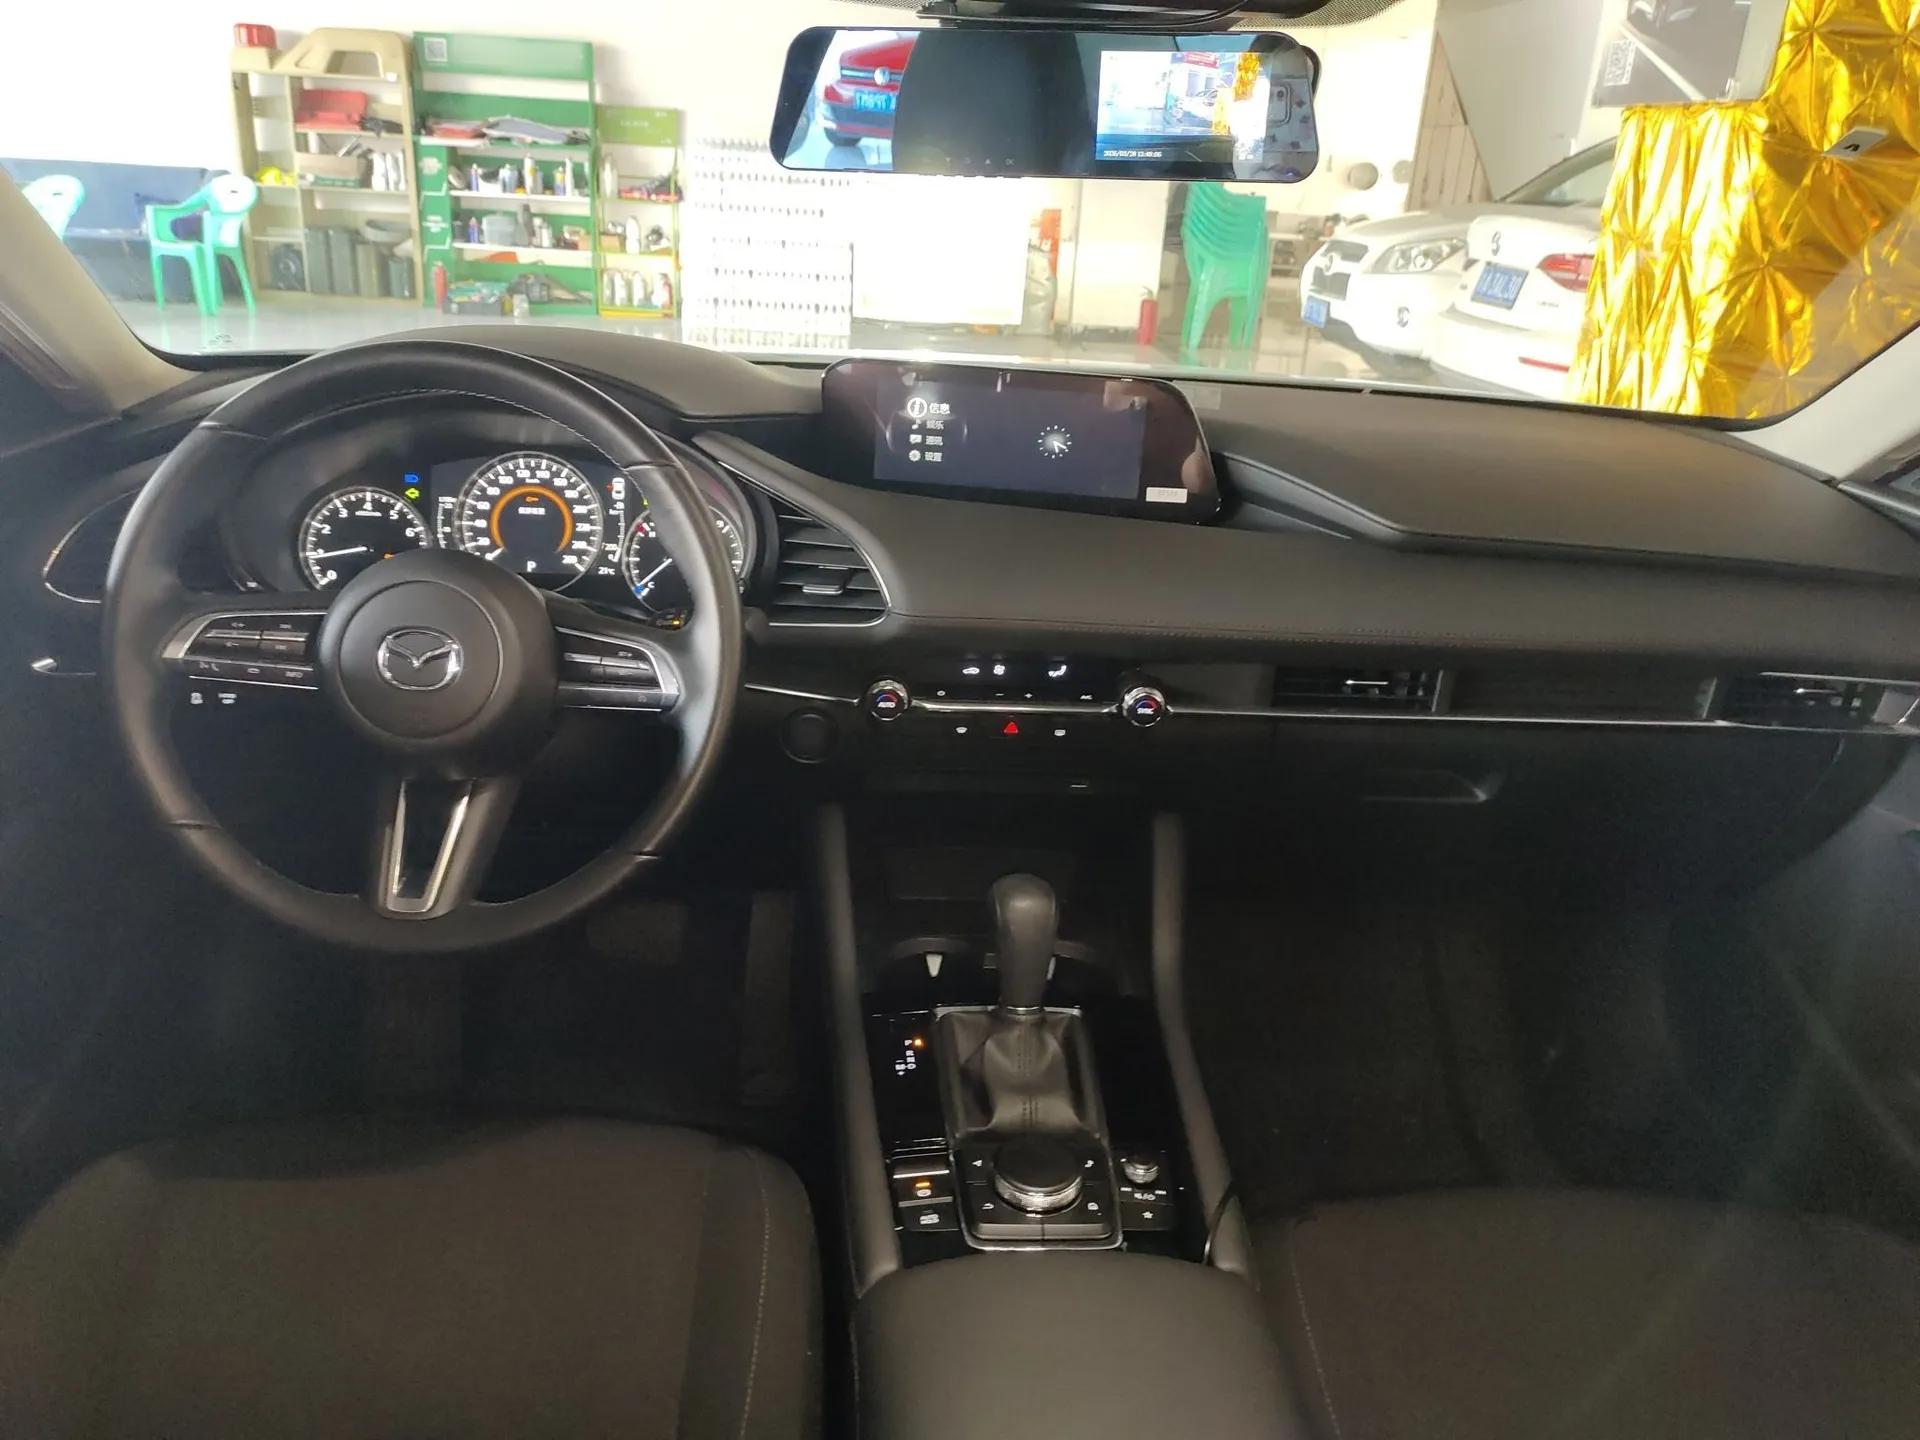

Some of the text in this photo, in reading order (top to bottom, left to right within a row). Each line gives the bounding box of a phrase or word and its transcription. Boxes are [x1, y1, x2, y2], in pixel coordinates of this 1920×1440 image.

[929, 402, 951, 415] 信息
[338, 508, 349, 518] 3
[389, 509, 400, 520] 5
[321, 524, 332, 535] 2
[405, 527, 416, 538] 6
[527, 561, 537, 572] P
[326, 569, 338, 580] 0
